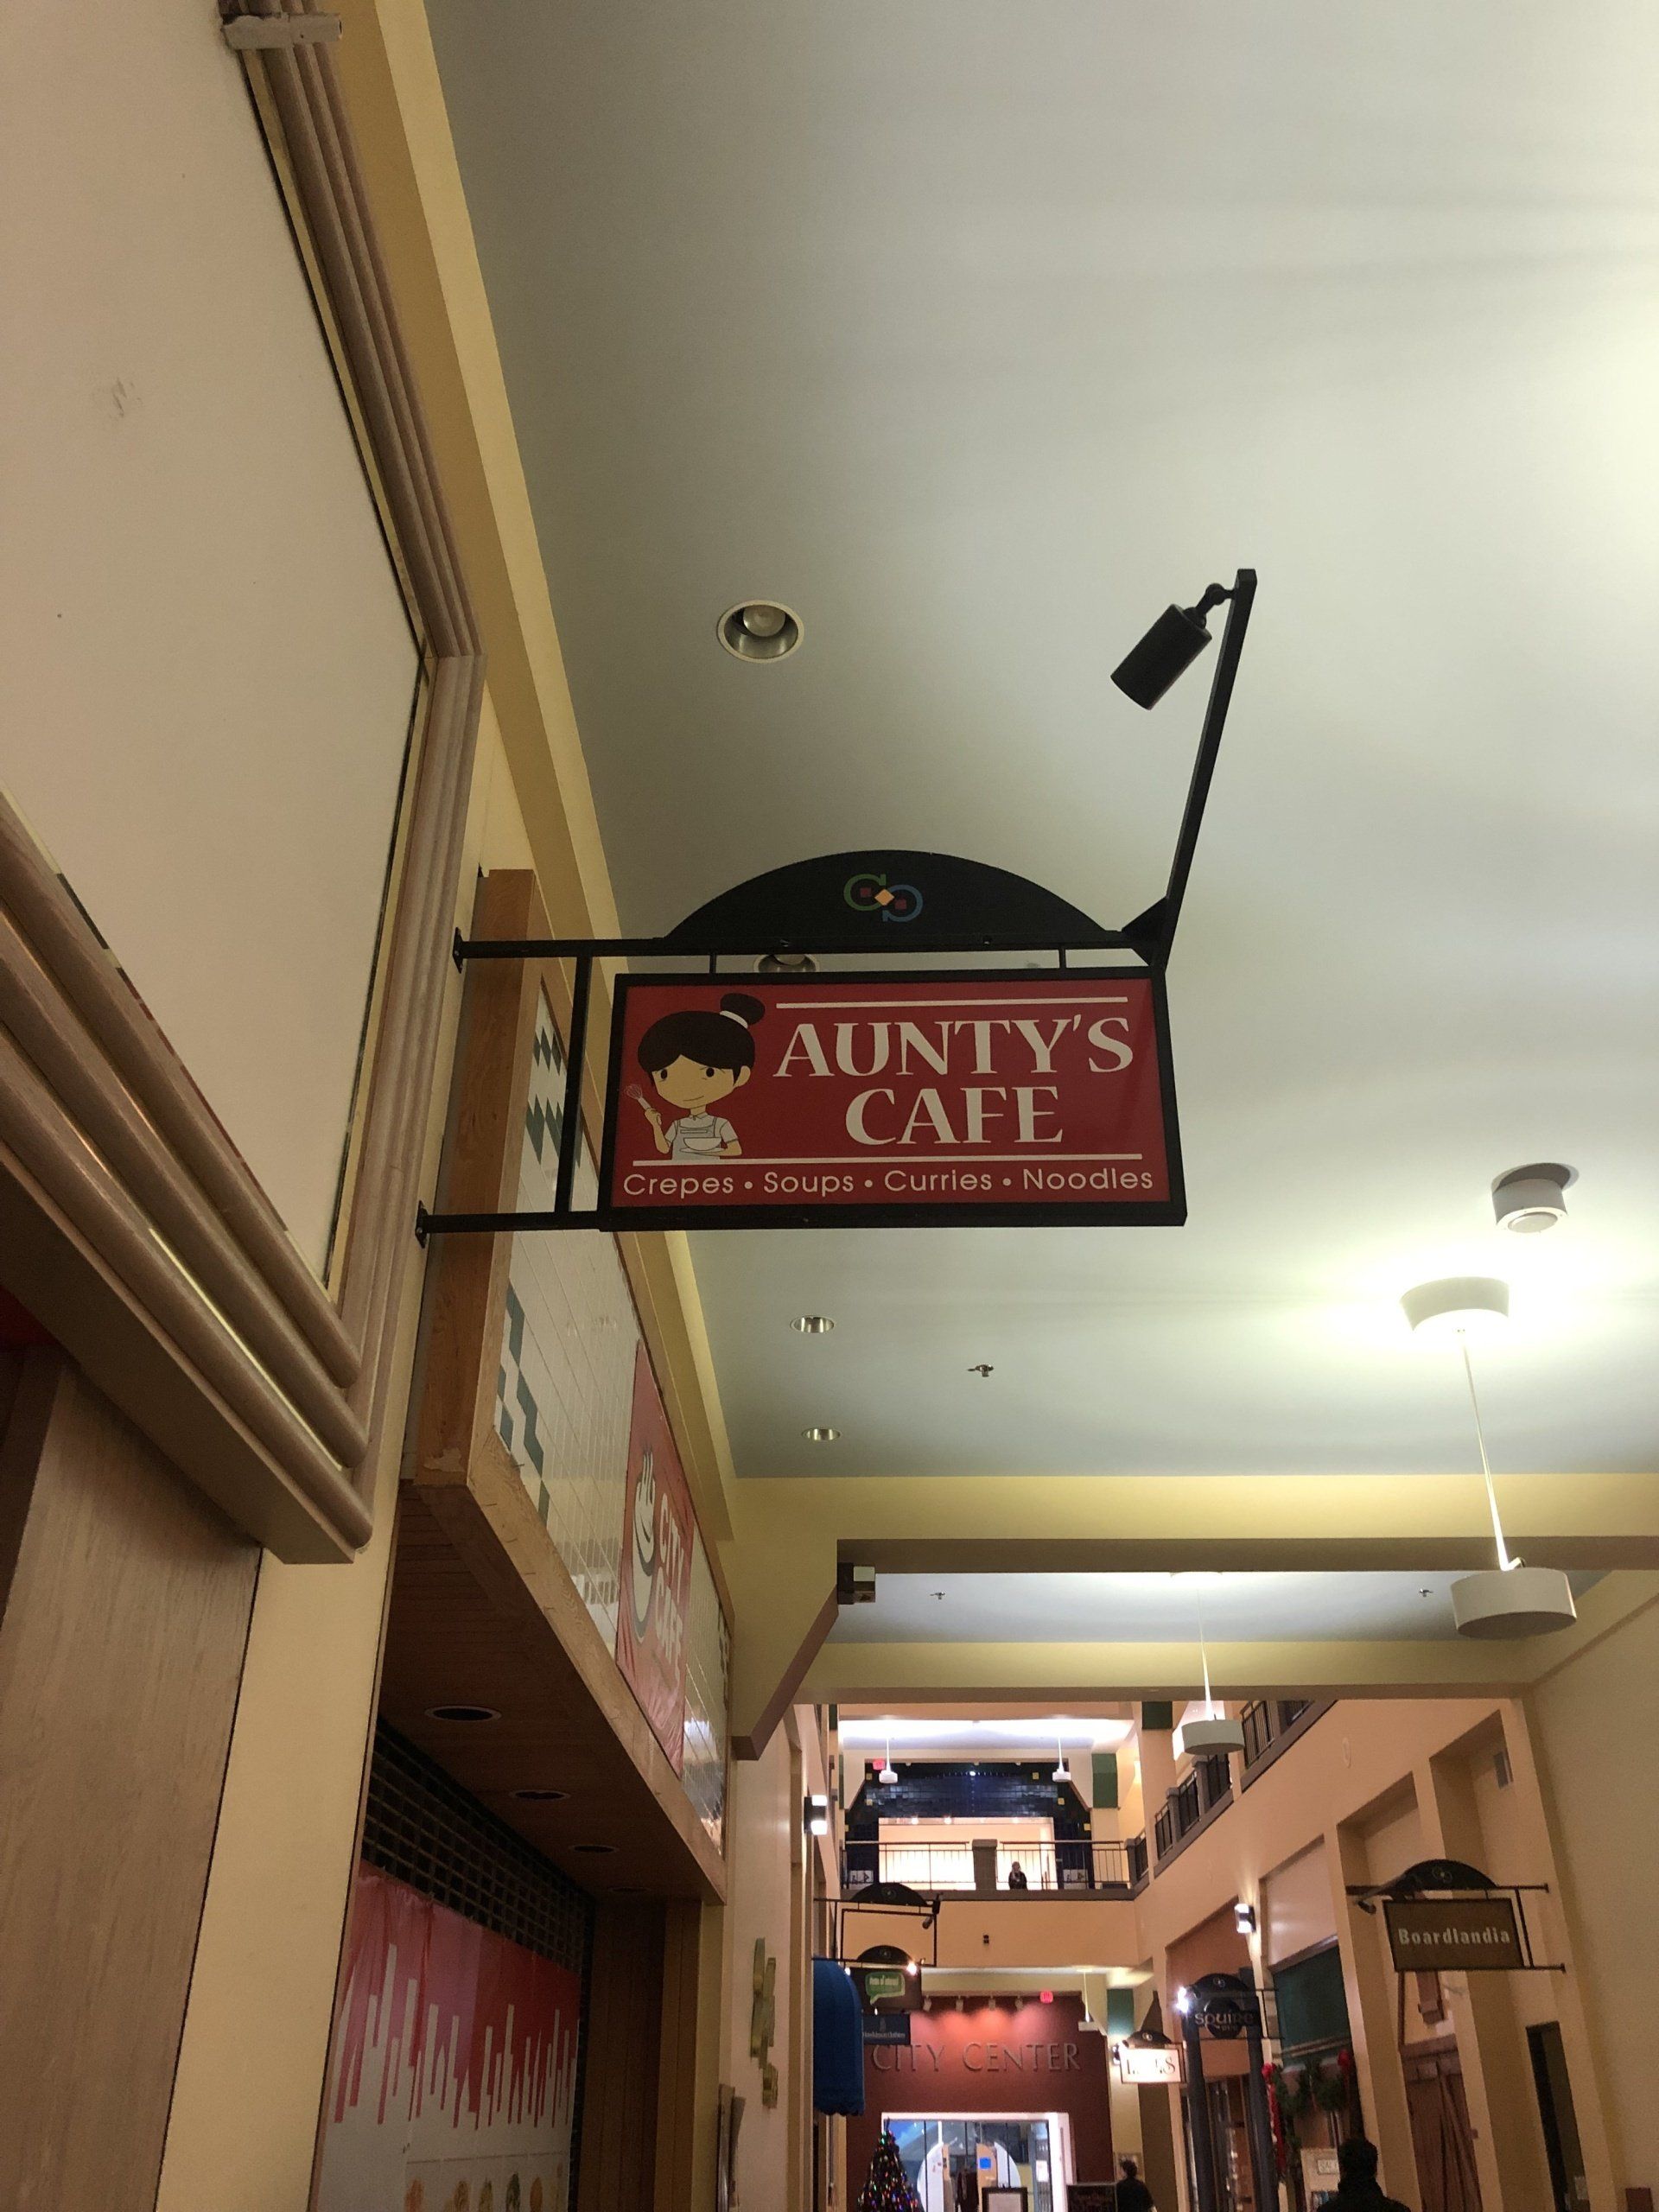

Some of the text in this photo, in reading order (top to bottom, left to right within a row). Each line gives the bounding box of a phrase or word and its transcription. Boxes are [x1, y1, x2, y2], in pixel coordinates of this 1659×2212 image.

[772, 1014, 1134, 1078] AUNTY'S
[843, 1085, 1064, 1146] CAFE
[623, 1167, 1154, 1199] Crepes Soups Curries Noodles
[659, 1492, 684, 1605] CITY
[655, 1565, 683, 1691] CAFE
[1397, 1926, 1510, 1946] Boardlandia
[872, 2042, 1082, 2072] CITY CENTER
